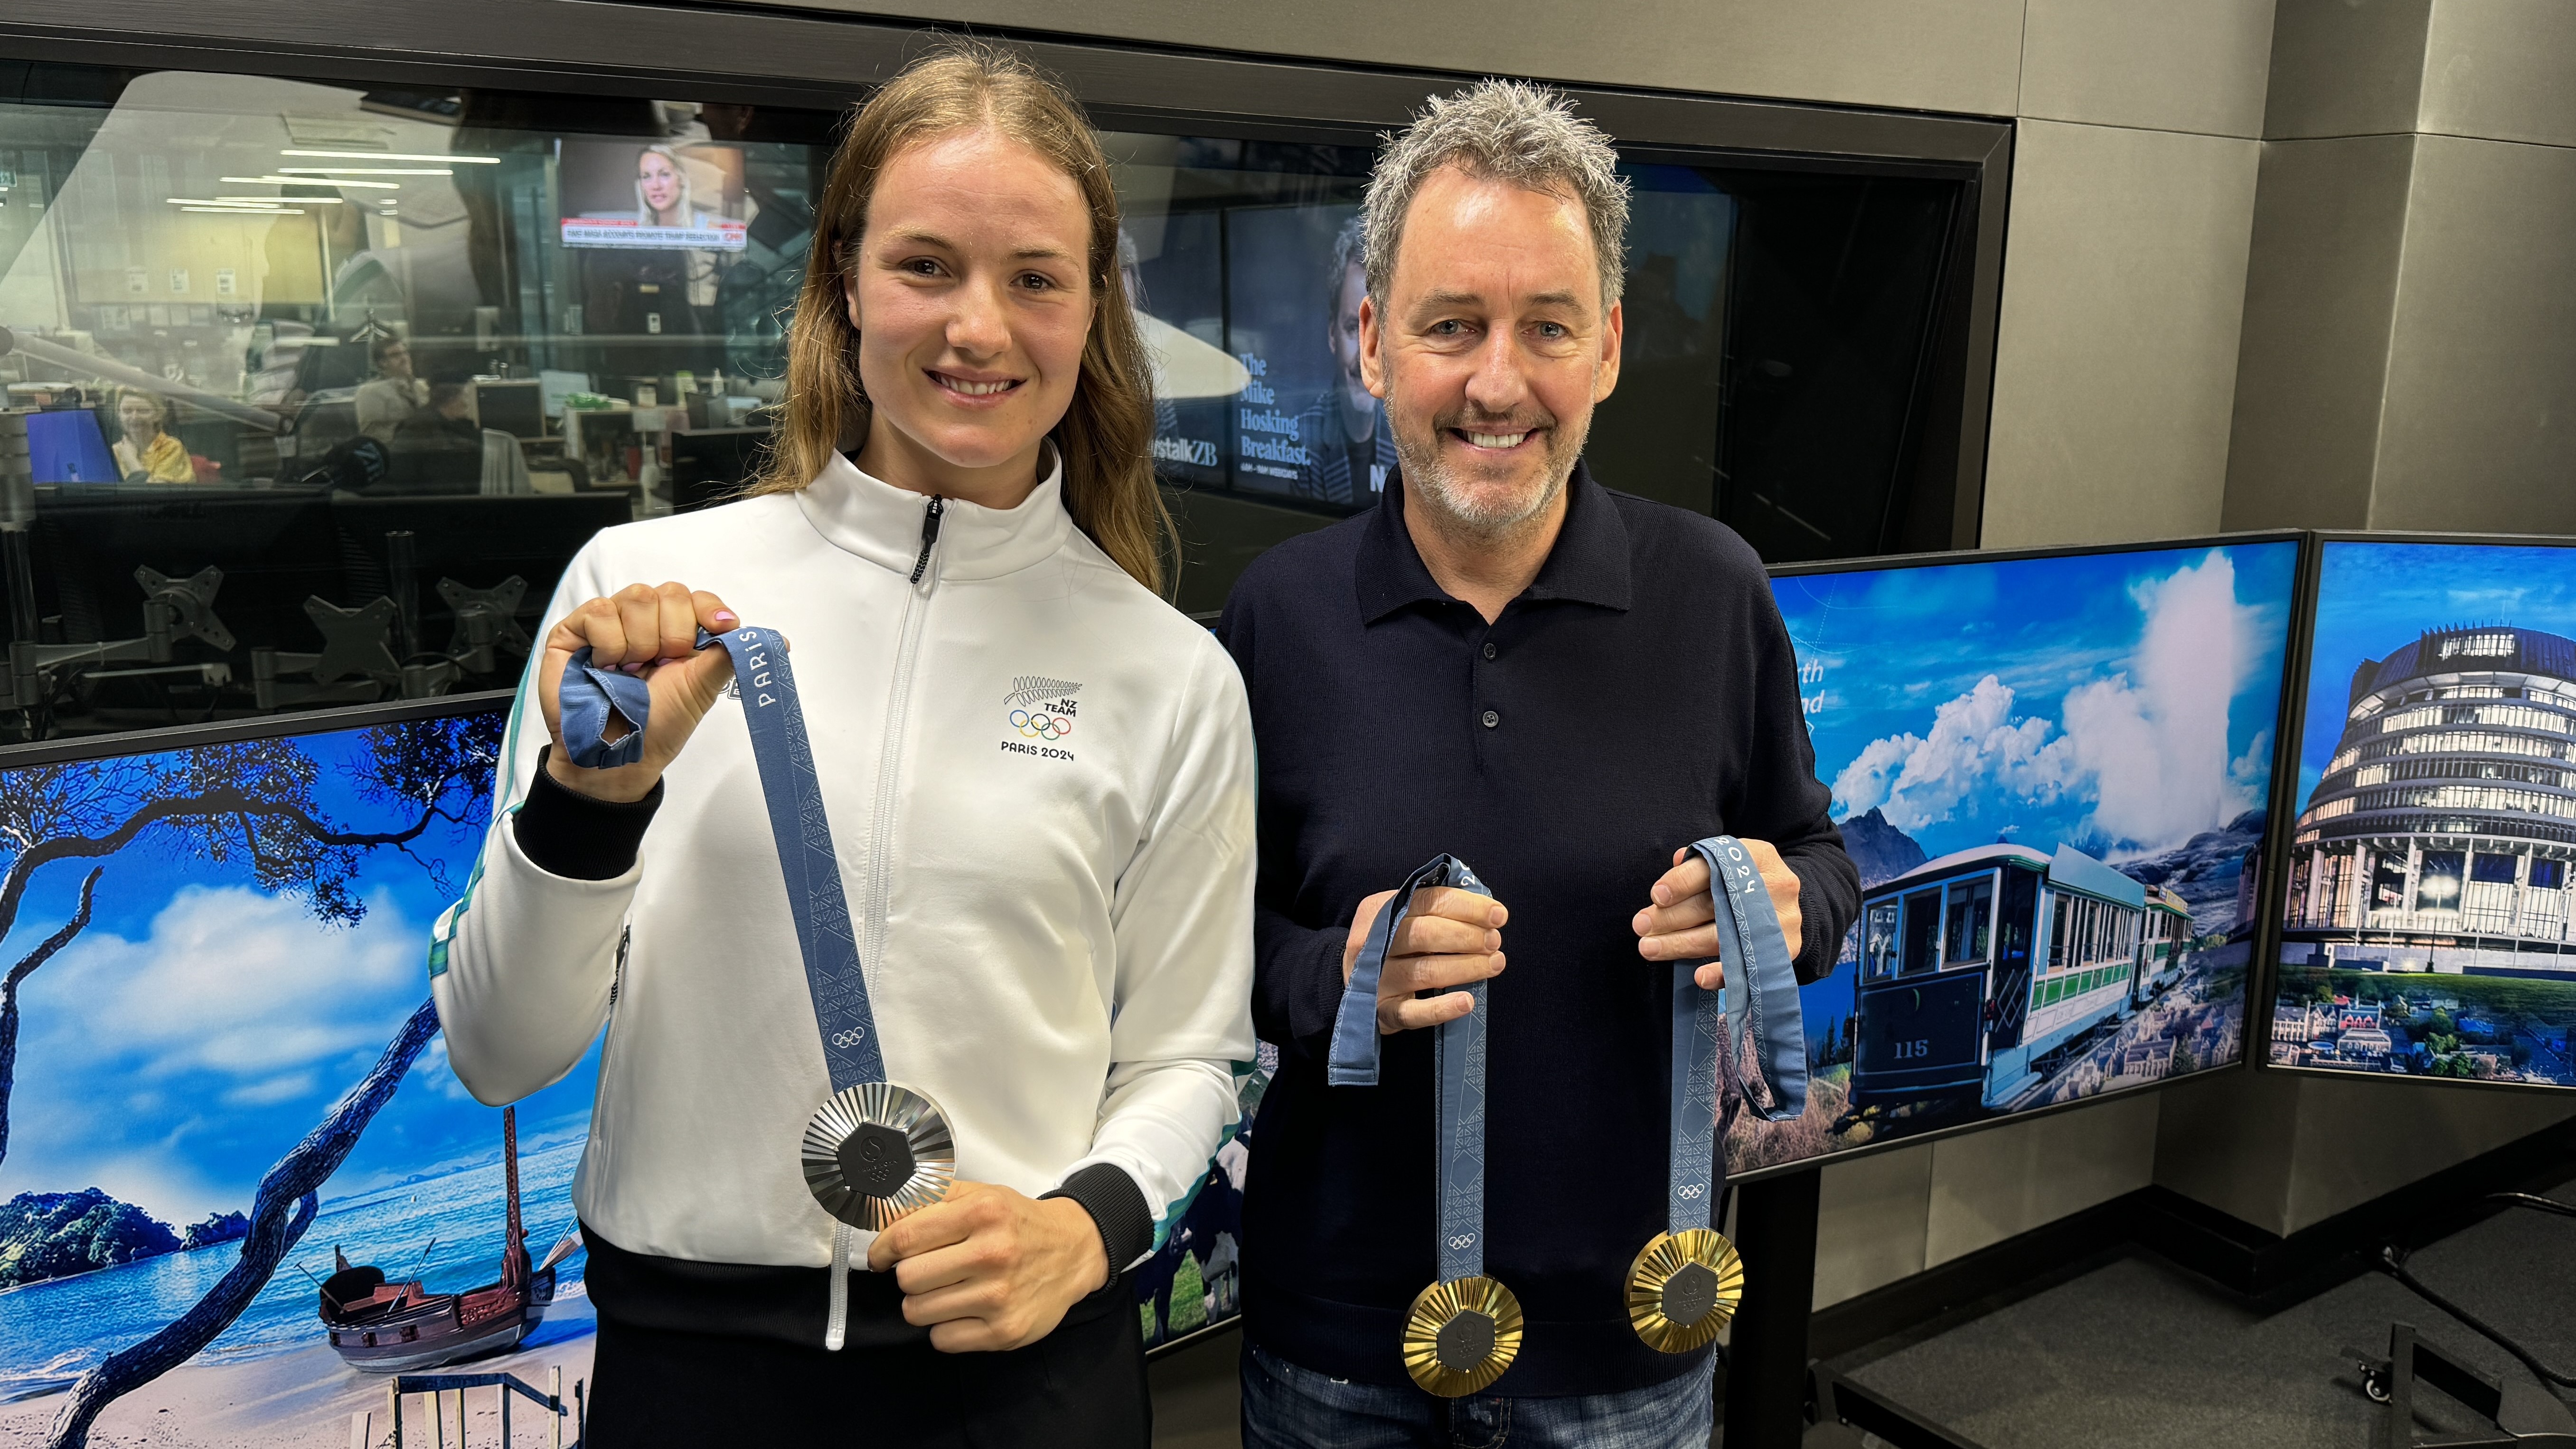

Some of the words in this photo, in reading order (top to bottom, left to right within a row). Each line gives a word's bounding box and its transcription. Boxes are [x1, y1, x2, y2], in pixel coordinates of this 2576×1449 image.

[1240, 353, 1267, 376] The
[1240, 380, 1275, 405] Mike
[1241, 408, 1299, 442] Hosking
[1044, 703, 1076, 717] TEAM
[1061, 698, 1078, 709] NZ
[1041, 747, 1074, 761] 2024
[1714, 837, 1755, 893] 2024
[1894, 1039, 1929, 1059] 115
